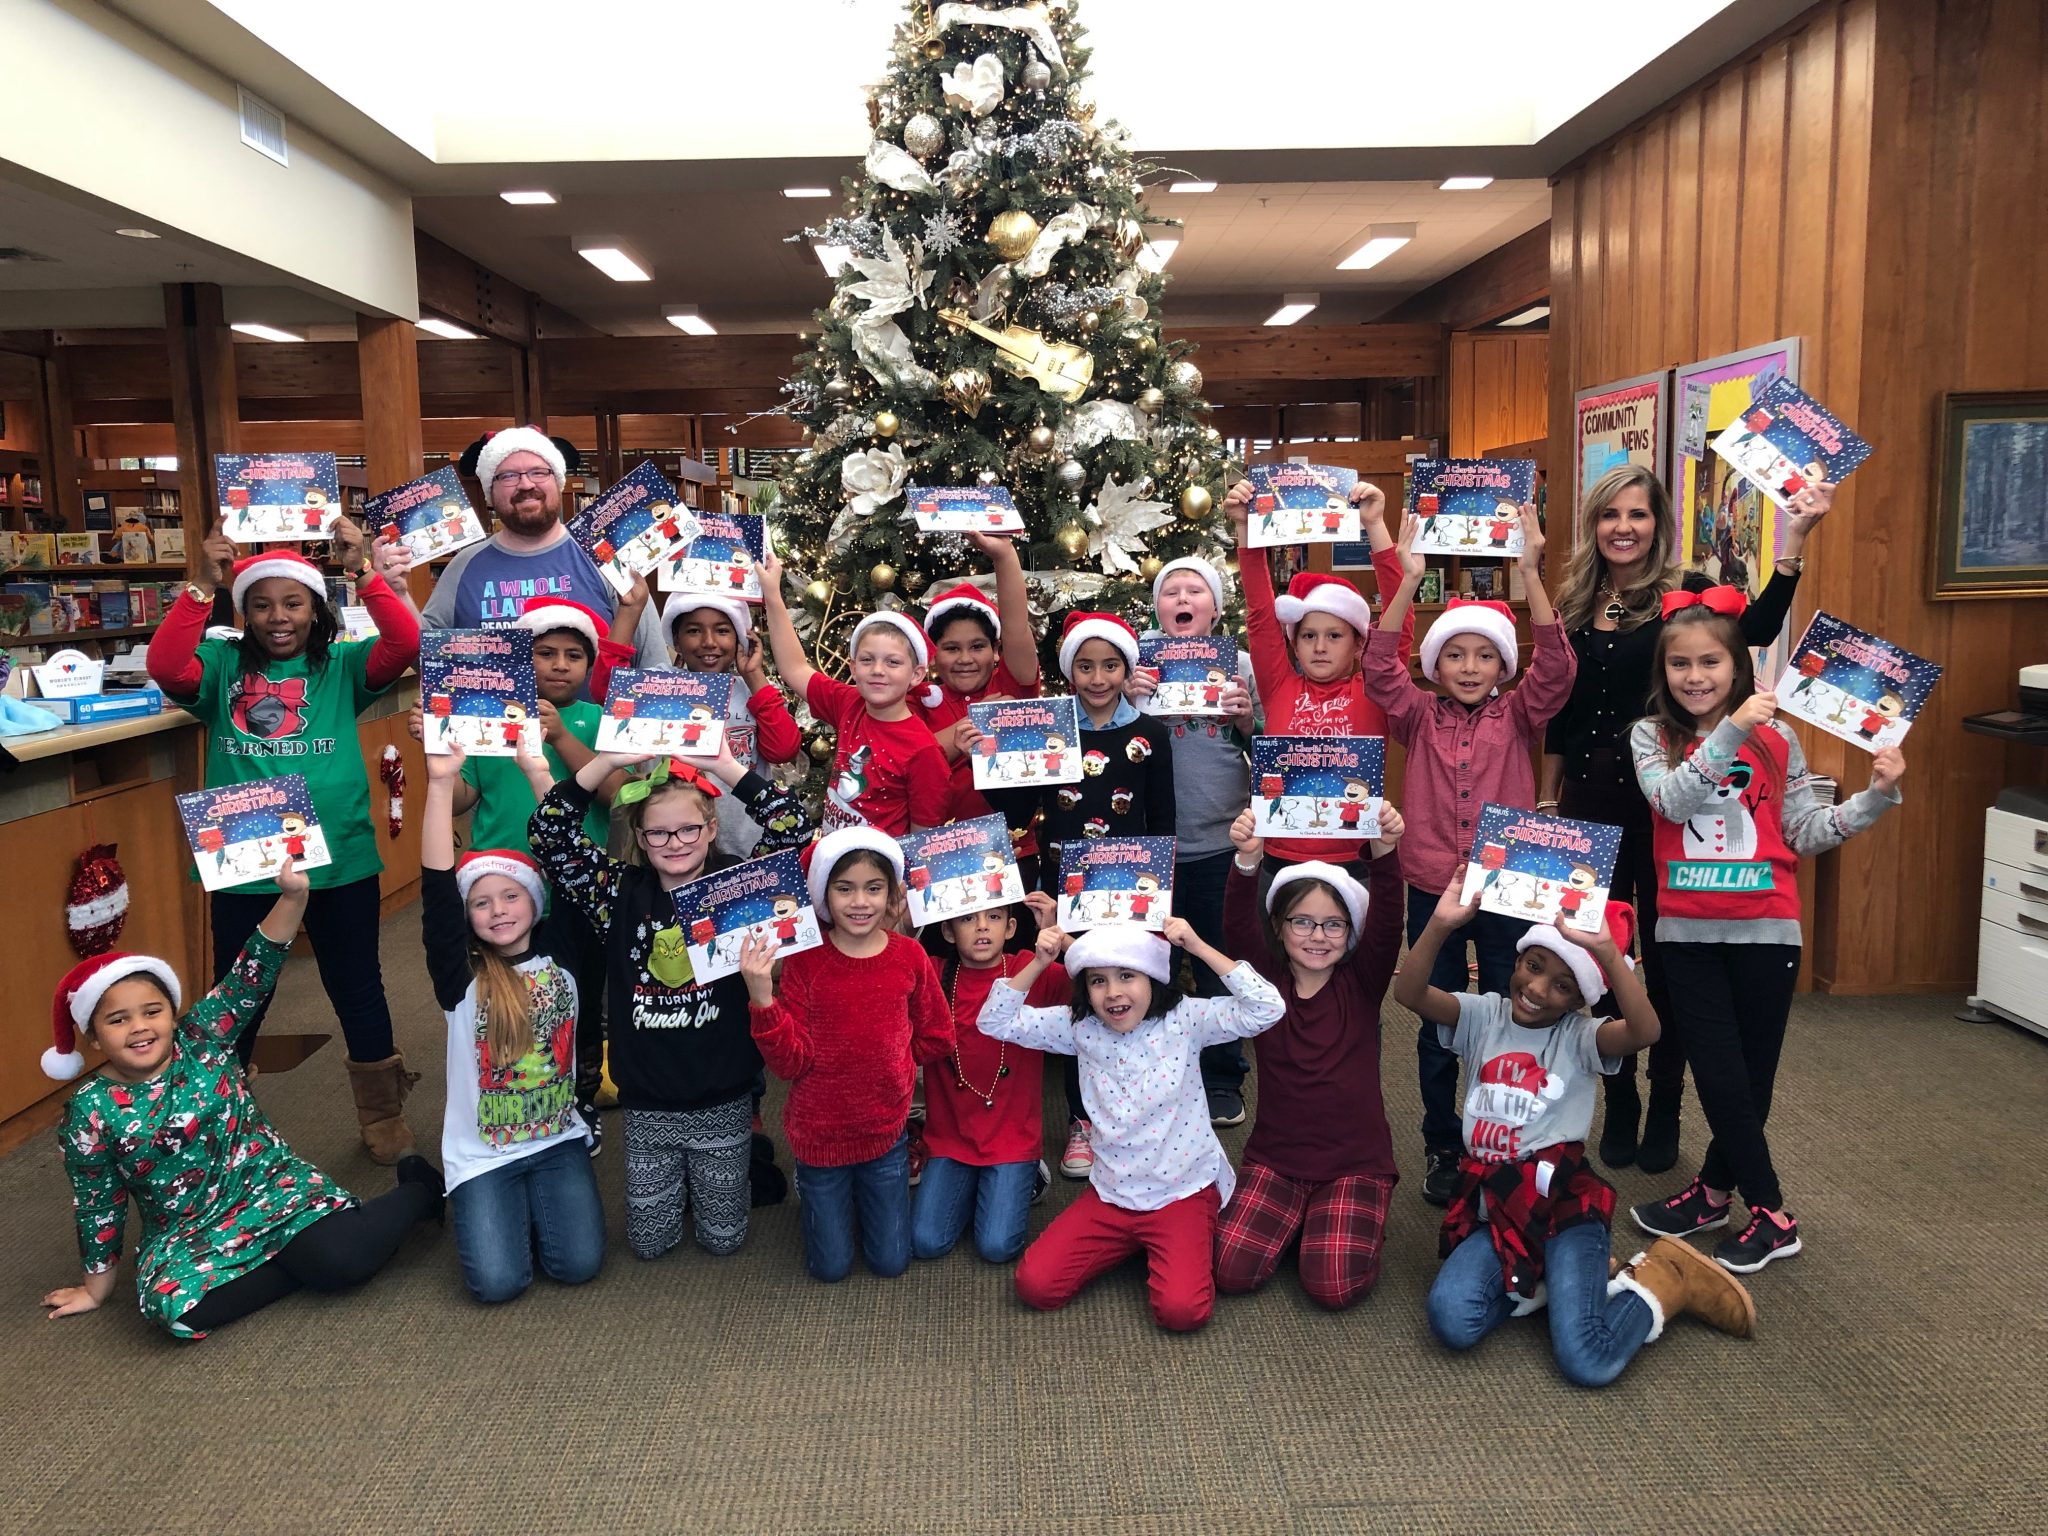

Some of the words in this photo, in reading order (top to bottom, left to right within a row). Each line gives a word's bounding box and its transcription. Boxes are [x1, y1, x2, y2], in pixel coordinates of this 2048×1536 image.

[1586, 405, 1638, 435] COMMUNITY
[1780, 403, 1843, 455] CHRISTMAS
[1622, 429, 1649, 451] NEWS
[240, 467, 315, 480] CHRISTMAS
[1434, 474, 1511, 488] CHRISTMAS
[384, 484, 443, 515] CHRISTMAS
[591, 484, 648, 532] CHRISTMAS
[484, 581, 496, 598] A
[500, 575, 572, 596] WHOLE
[441, 642, 512, 654] CHRISTMAS
[1154, 648, 1218, 660] CHRISTMAS
[1829, 639, 1910, 684] CHRISTMAS
[443, 675, 515, 691] CHRISTMAS
[632, 682, 707, 696] CHRISTMAS
[80, 705, 90, 713] 60
[989, 713, 1055, 727] CHRISTMAS
[312, 739, 336, 754] IT
[1277, 753, 1358, 768] CHRISTMAS
[207, 791, 288, 817] CHRISTMAS
[1486, 807, 1509, 817] PEANUTS
[918, 831, 989, 857] CHRISTMAS
[1504, 825, 1592, 853] CHRISTMAS
[1081, 850, 1151, 864] CHRISTMAS
[1675, 867, 1768, 888] CHILLIN'
[700, 872, 779, 907] CHRISTMAS
[633, 993, 652, 1005] ME
[658, 993, 692, 1005] TURN
[697, 987, 713, 1001] MY
[633, 1005, 692, 1030] Grinch
[695, 1001, 719, 1028] On
[1497, 1059, 1526, 1082] I'M
[478, 1078, 574, 1126] CHRISTMA
[1475, 1088, 1495, 1112] IN
[1504, 1093, 1539, 1121] THE
[1471, 1119, 1523, 1155] NICE
